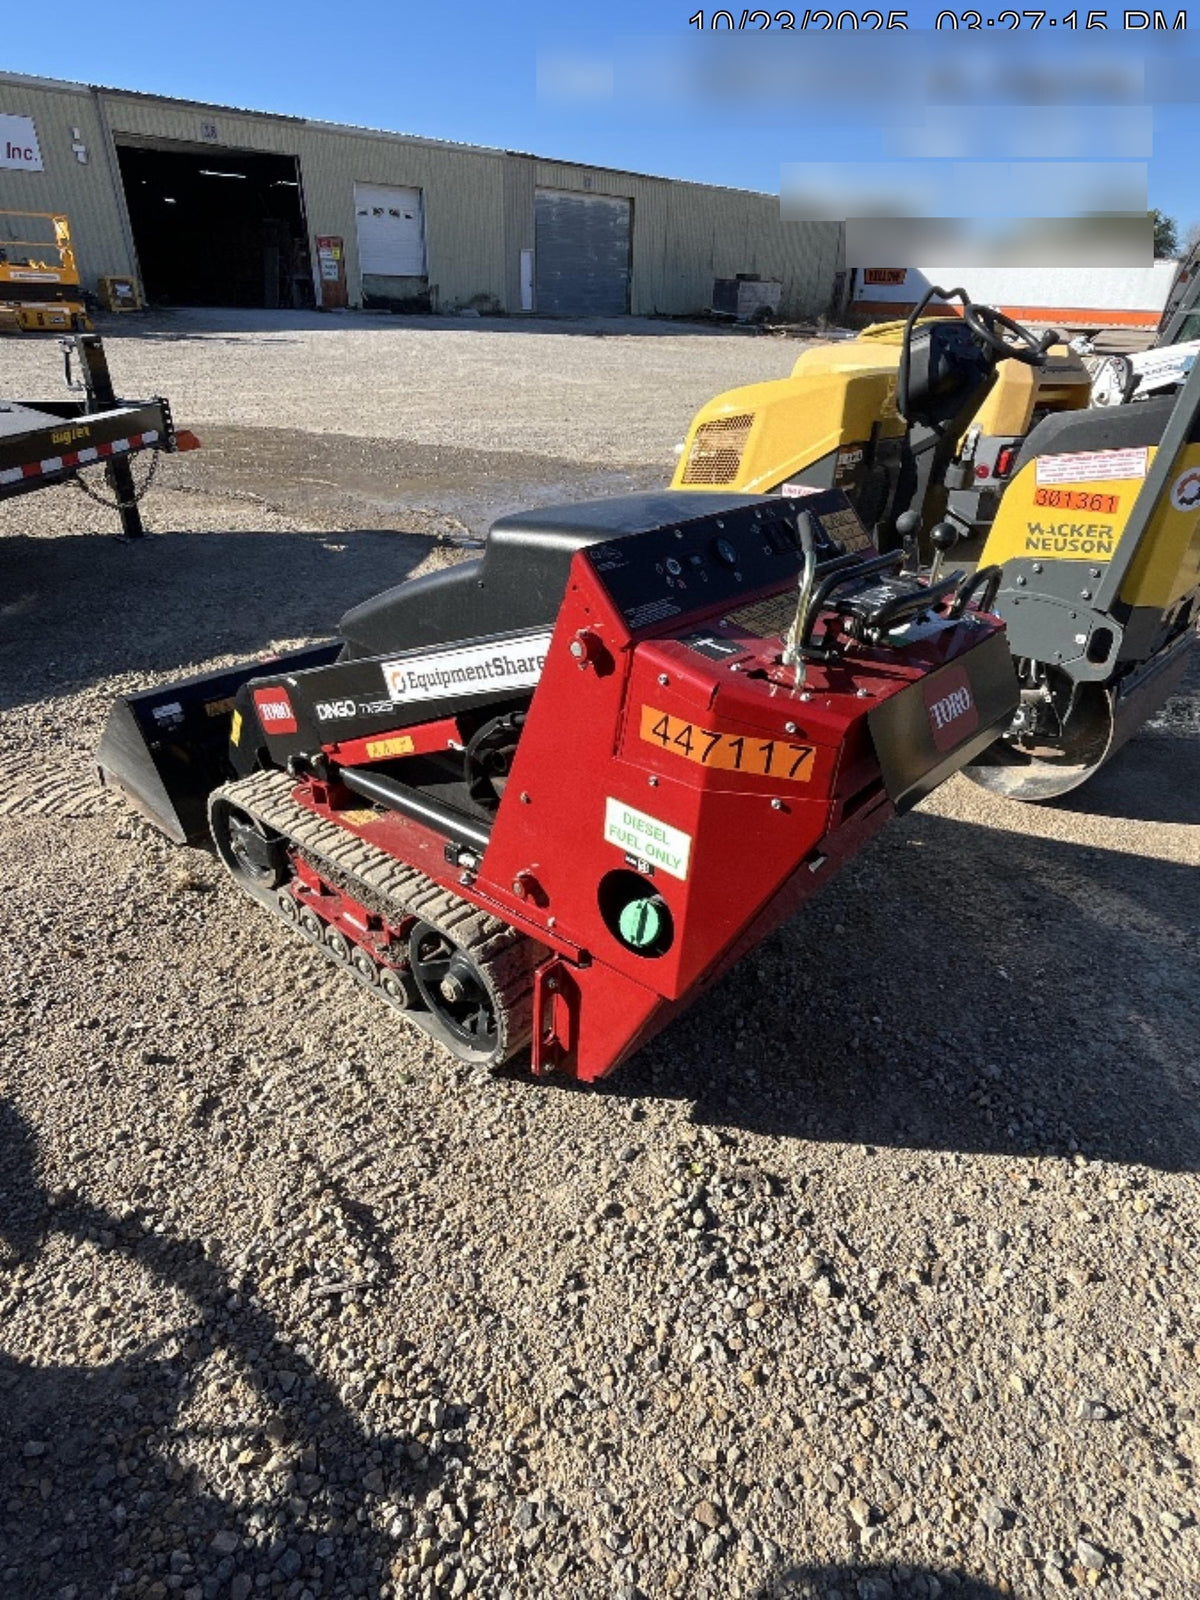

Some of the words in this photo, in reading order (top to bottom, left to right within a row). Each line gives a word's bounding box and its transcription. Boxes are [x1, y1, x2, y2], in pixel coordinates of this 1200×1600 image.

[6, 142, 38, 162] Inc.
[1036, 488, 1115, 512] 301361
[1027, 522, 1114, 539] WACKER
[1025, 537, 1113, 554] NEUSON
[408, 654, 545, 691] EquipmentShare
[259, 702, 295, 720] TORO
[316, 700, 356, 720] DINGO
[930, 686, 970, 729] TORO
[652, 715, 813, 777] 447117
[622, 811, 670, 845] DIESEL
[609, 824, 641, 850] FUEL
[644, 843, 683, 870] ONLY
